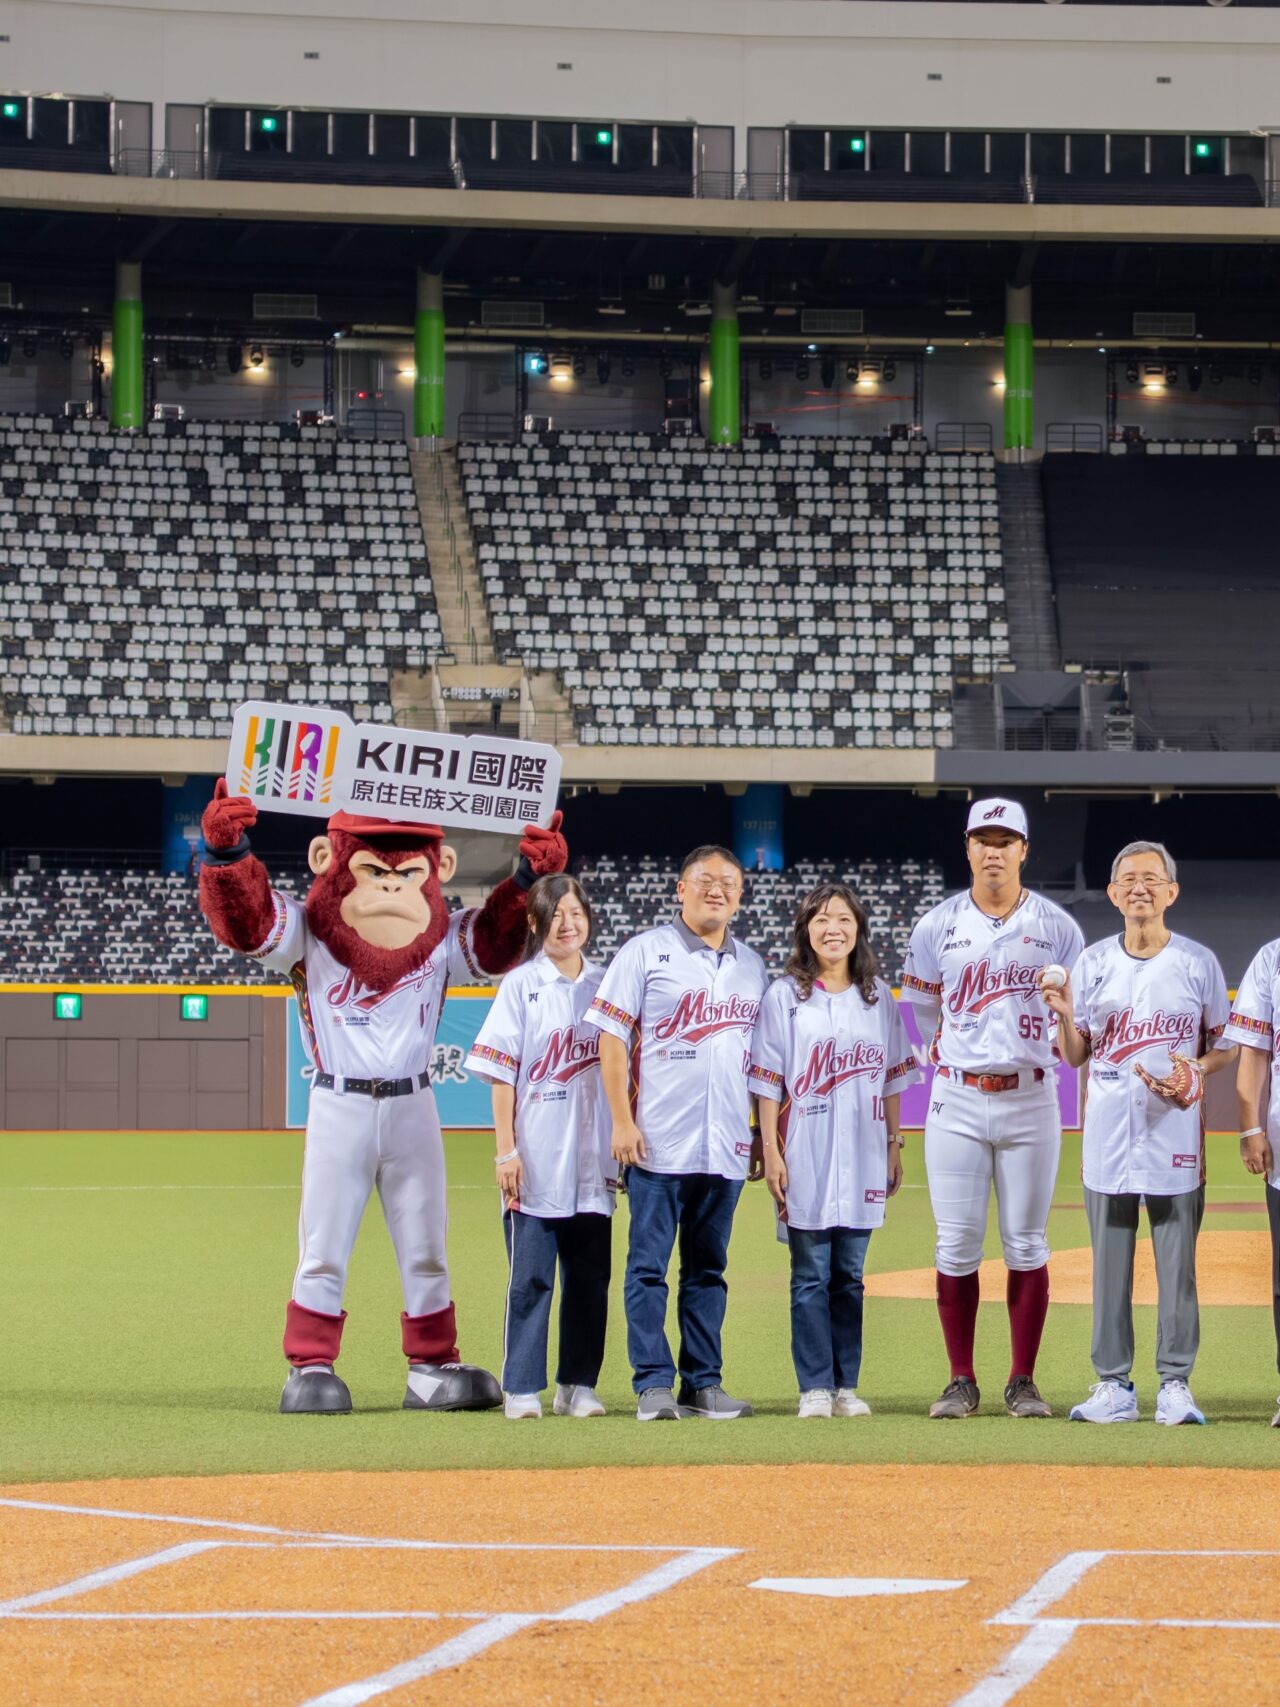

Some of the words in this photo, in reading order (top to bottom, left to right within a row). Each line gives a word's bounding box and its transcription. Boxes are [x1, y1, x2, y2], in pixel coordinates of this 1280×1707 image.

[239, 716, 340, 804] KIRI
[356, 739, 460, 780] KIRI
[467, 750, 547, 793] 國際
[351, 779, 541, 822] 原住民族文創園區
[652, 988, 760, 1046] Monkey
[1018, 1014, 1044, 1041] 95
[1093, 1007, 1195, 1067] Monkeys
